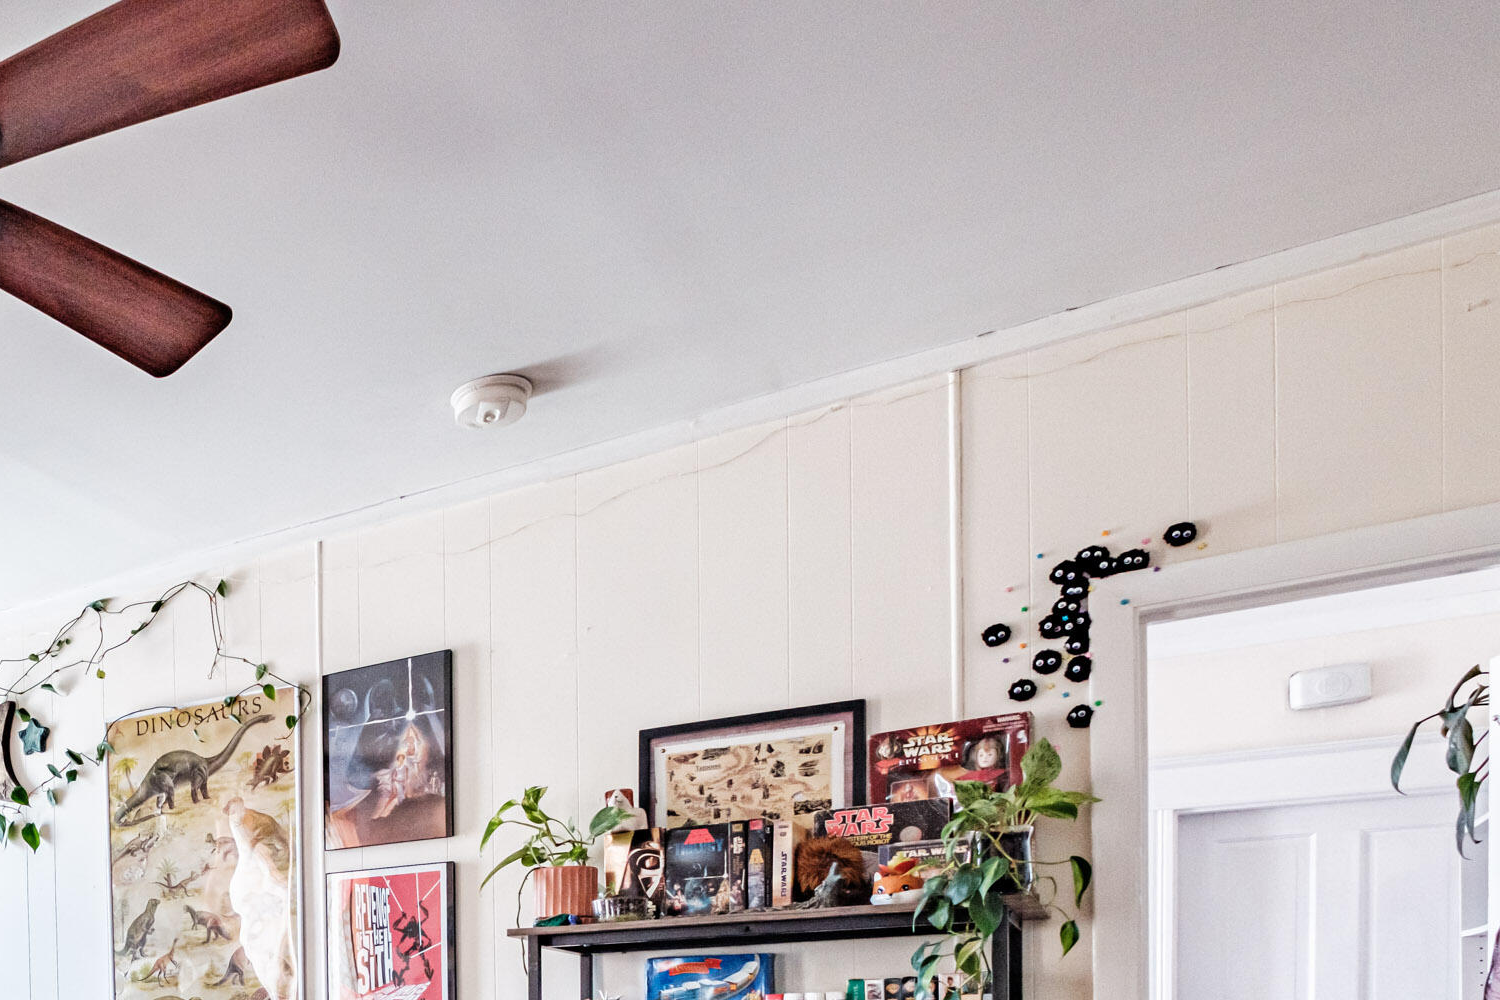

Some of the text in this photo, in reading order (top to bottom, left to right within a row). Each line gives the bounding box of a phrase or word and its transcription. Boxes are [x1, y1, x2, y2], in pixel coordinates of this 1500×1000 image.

[903, 733, 953, 747] STAR
[903, 742, 954, 758] WARS
[833, 807, 894, 824] STAR
[825, 819, 894, 837] WARS
[355, 883, 390, 929] REVENGE
[357, 941, 393, 995] SITH
